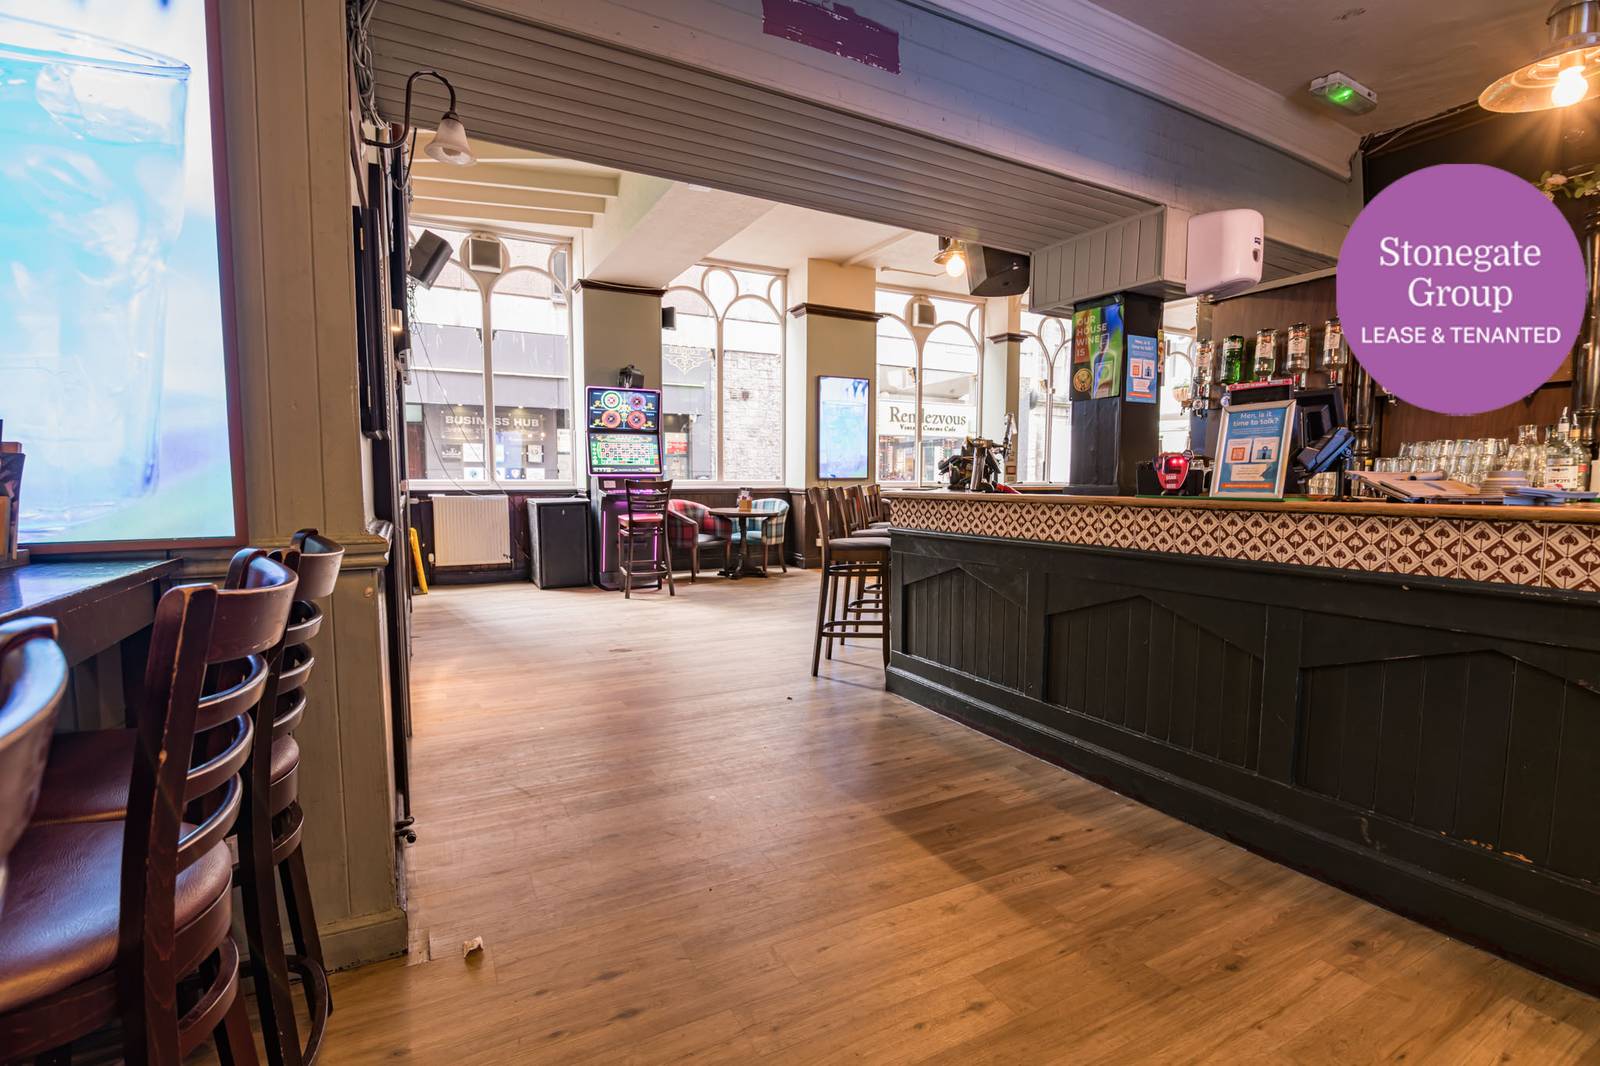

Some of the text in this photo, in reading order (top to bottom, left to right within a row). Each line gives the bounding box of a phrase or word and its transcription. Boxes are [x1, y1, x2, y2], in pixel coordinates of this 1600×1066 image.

[1078, 315, 1096, 326] OUR
[1077, 322, 1107, 336] HOUSE
[1076, 334, 1100, 346] WINE
[1077, 348, 1086, 357] IS
[445, 415, 539, 427] BUSINSS HUB
[1260, 417, 1279, 425] talk?
